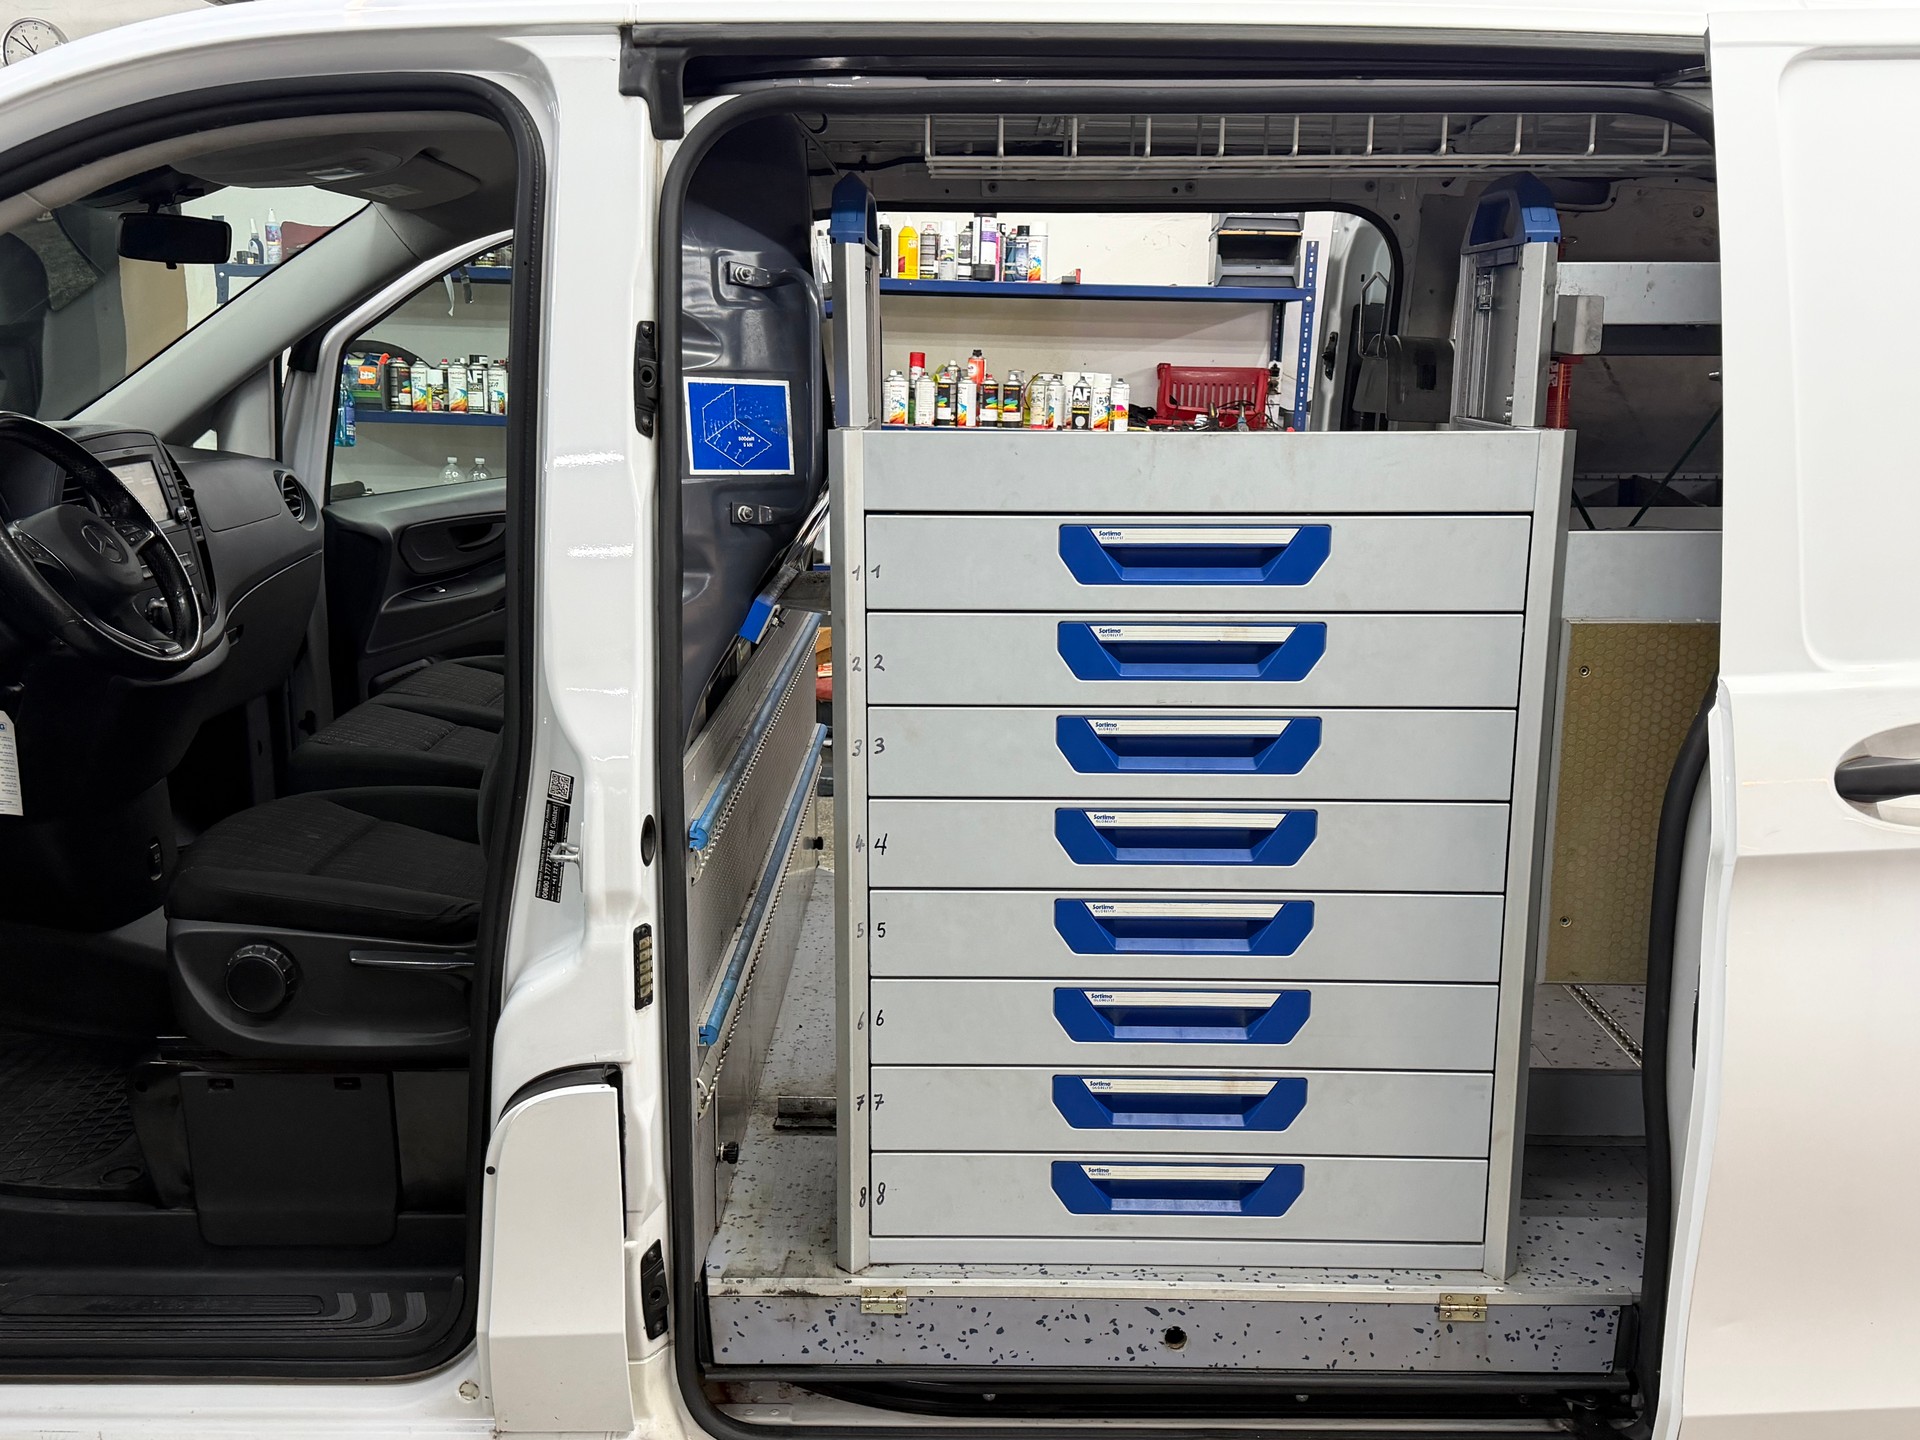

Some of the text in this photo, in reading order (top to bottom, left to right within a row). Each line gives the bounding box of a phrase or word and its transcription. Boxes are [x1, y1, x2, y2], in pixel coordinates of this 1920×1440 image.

[1073, 387, 1091, 400] AF
[852, 564, 880, 581] 1 1
[852, 654, 885, 672] 2 2
[852, 737, 885, 756] 3 3
[550, 806, 559, 828] Contact
[549, 830, 556, 840] MB
[856, 833, 888, 855] 4 4
[857, 922, 886, 938] 5 5
[858, 1009, 884, 1030] 6 6
[856, 1094, 884, 1111] 7 7
[859, 1182, 886, 1208] 8 8
